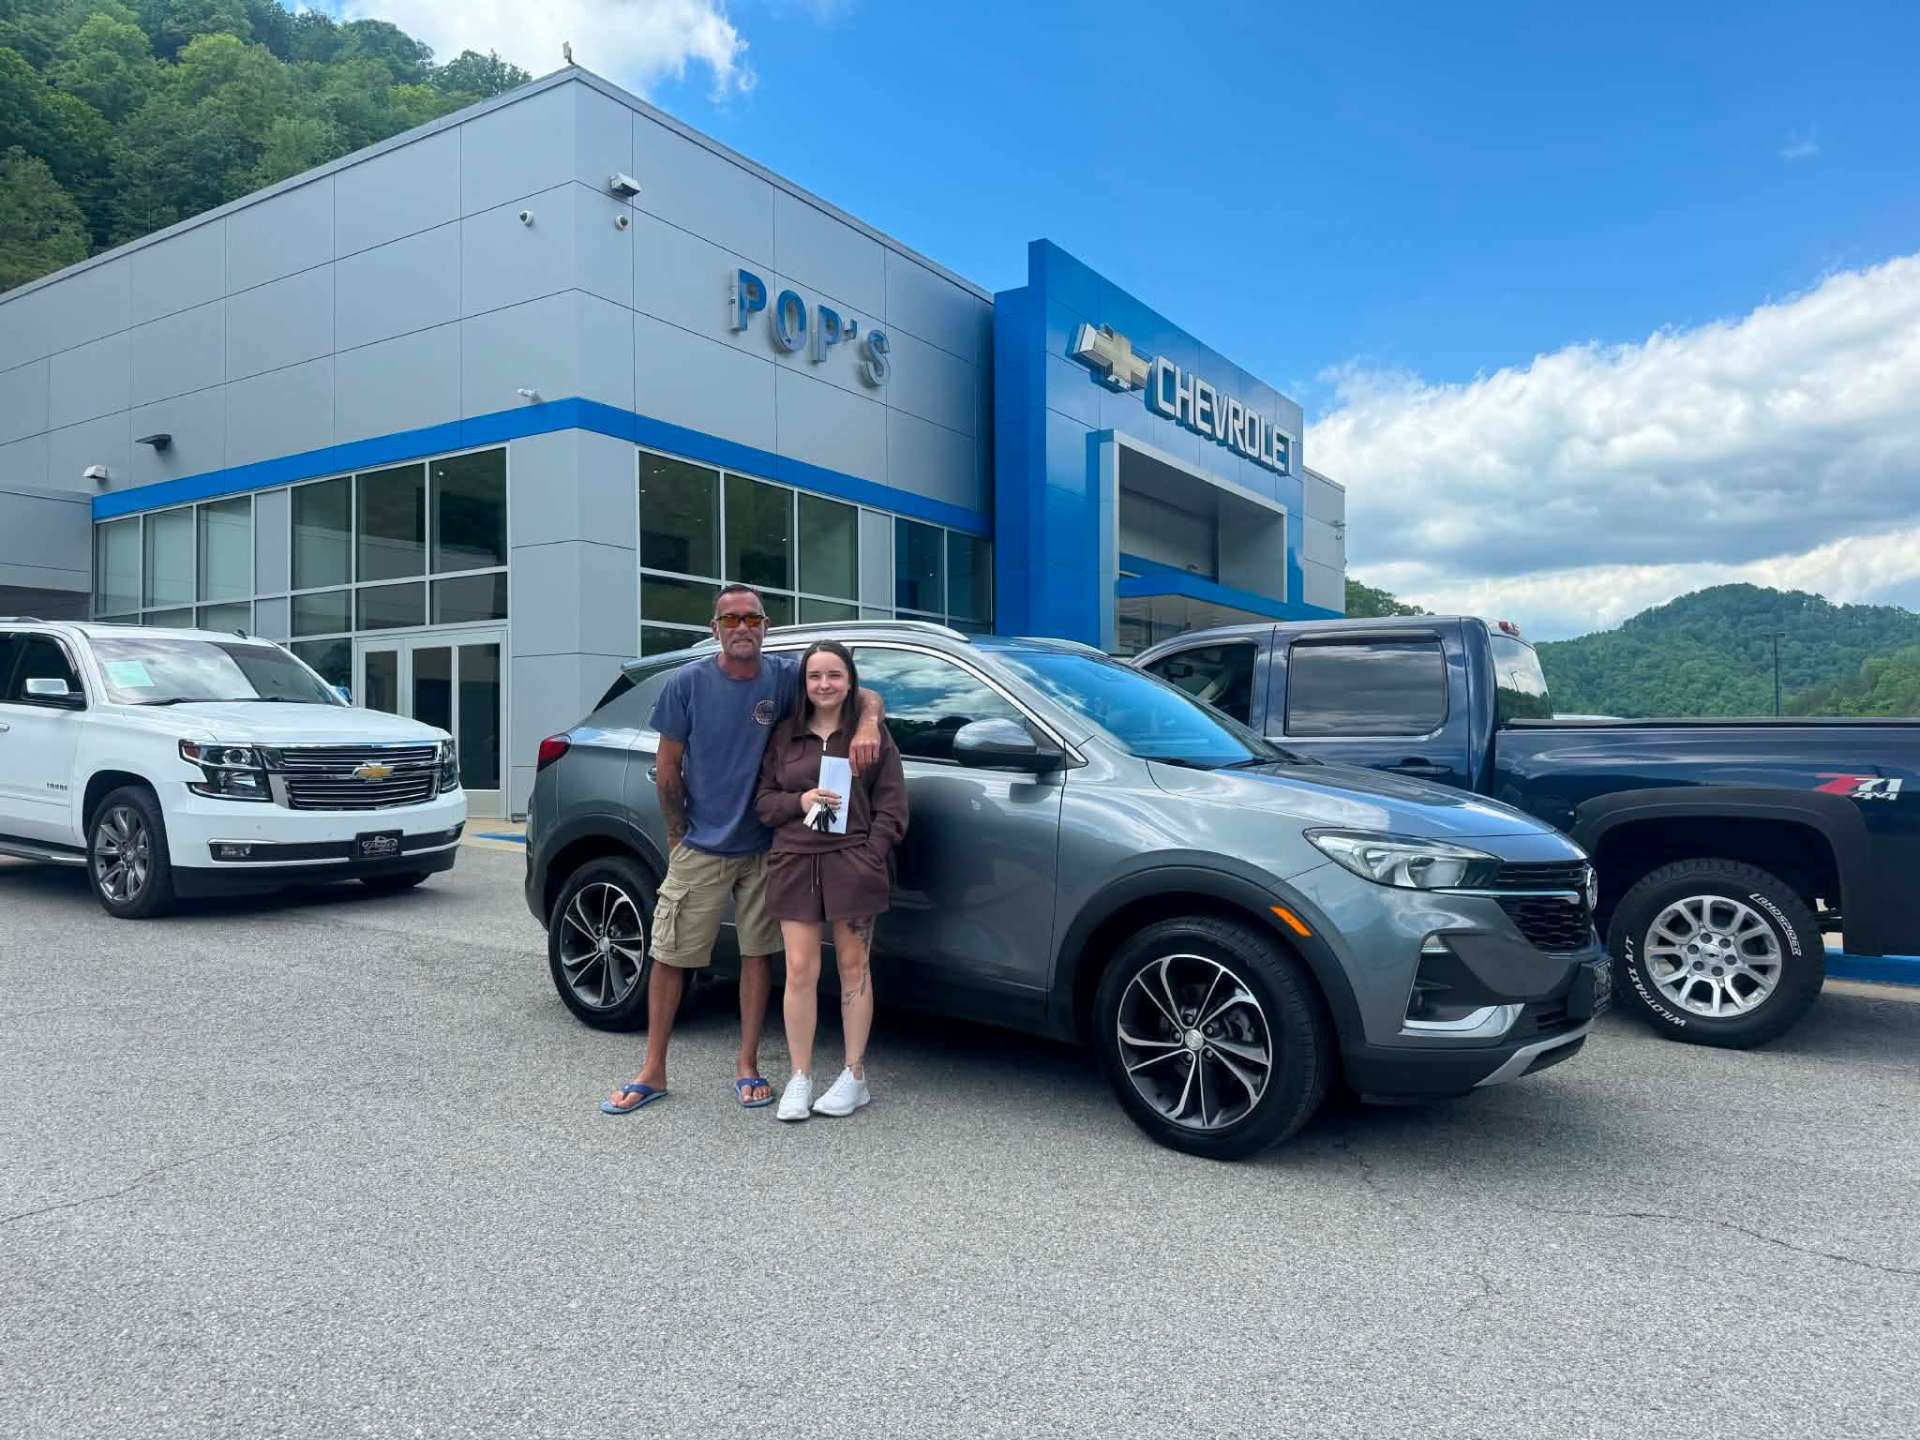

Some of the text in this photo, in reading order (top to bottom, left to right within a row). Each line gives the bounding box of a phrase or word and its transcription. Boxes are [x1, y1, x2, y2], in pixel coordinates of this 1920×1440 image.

[732, 268, 891, 385] POP'S
[1156, 355, 1296, 475] CHEVROLET
[1625, 935, 1687, 1027] WILDTRAXX A/T
